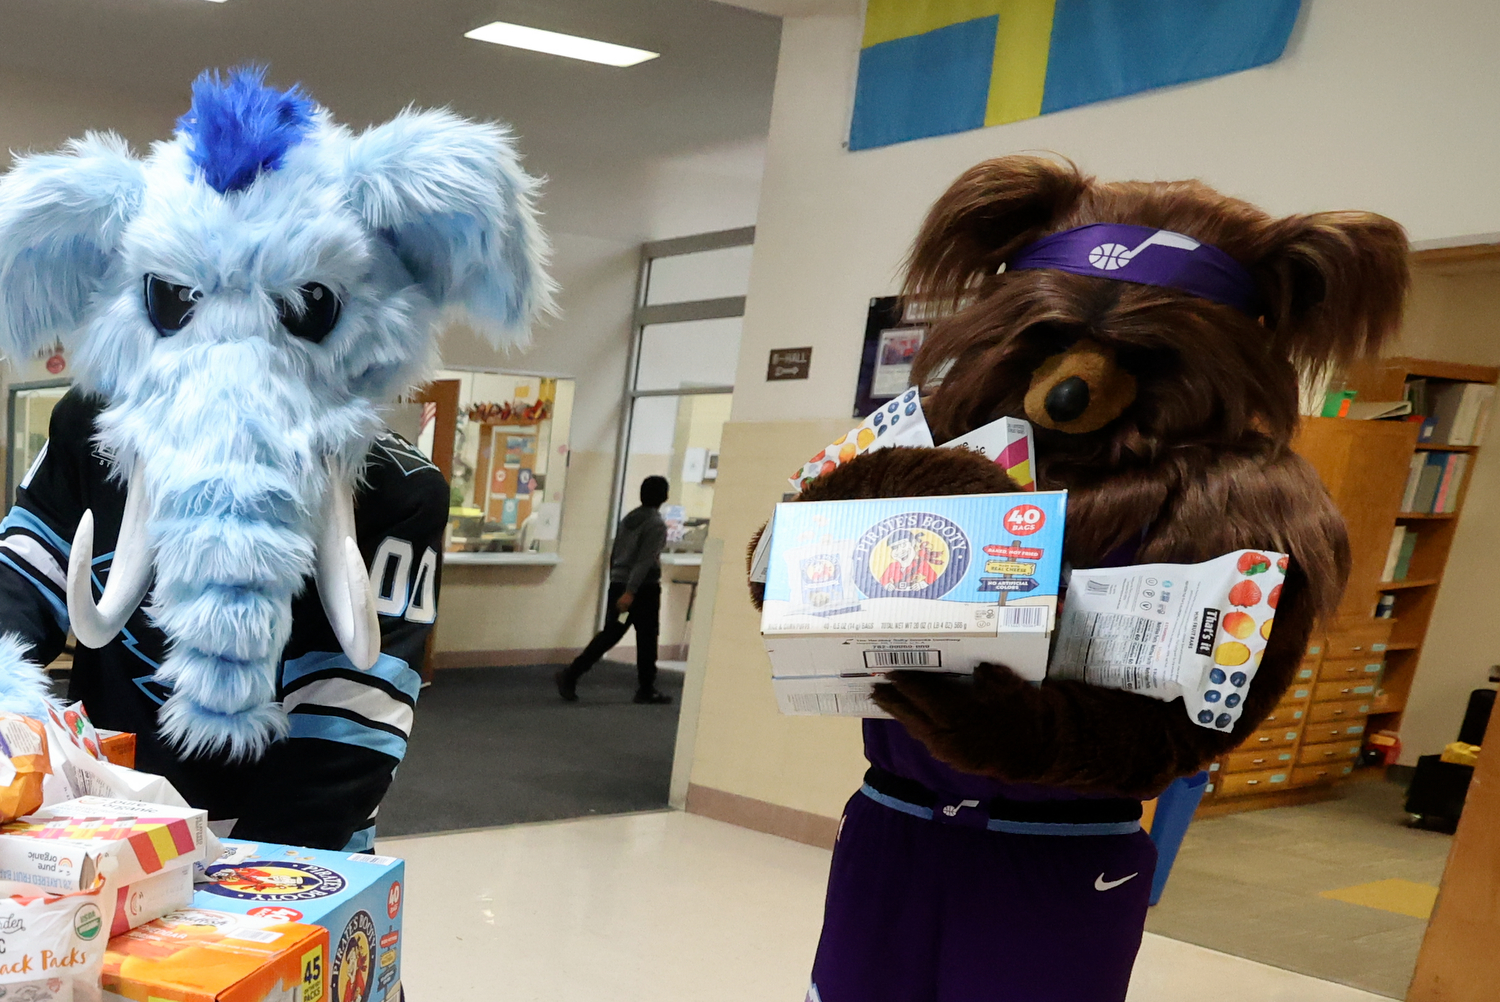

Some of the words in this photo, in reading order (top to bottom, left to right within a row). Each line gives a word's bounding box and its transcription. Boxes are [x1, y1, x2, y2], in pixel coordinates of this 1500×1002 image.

[1008, 509, 1041, 524] 40
[856, 515, 918, 553] PIRATE'S
[921, 516, 967, 551] BOOTY
[1202, 610, 1219, 640] That's
[1200, 641, 1212, 653] it
[27, 849, 58, 864] organic
[37, 861, 56, 871] pure
[251, 889, 328, 901] BOOTY
[389, 885, 400, 907] 40
[332, 916, 359, 976] PIRATE'S
[359, 913, 377, 951] BOOTY
[40, 946, 87, 970] Packs
[304, 955, 322, 986] 45
